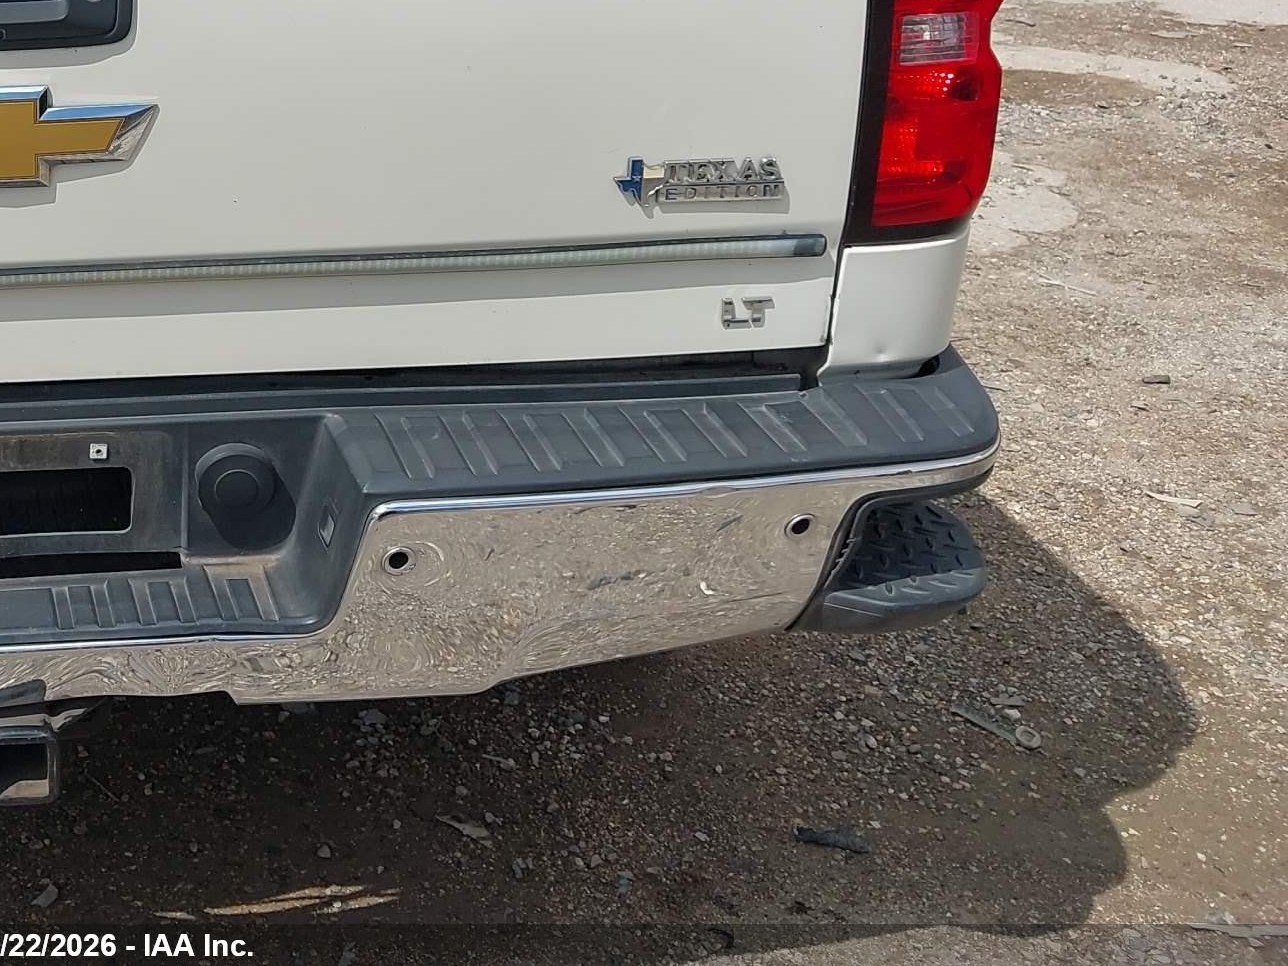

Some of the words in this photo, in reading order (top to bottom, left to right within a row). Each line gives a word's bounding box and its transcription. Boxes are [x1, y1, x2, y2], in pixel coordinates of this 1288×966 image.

[664, 157, 782, 184] TEXAS
[664, 184, 779, 201] EDITION
[721, 296, 775, 329] LT
